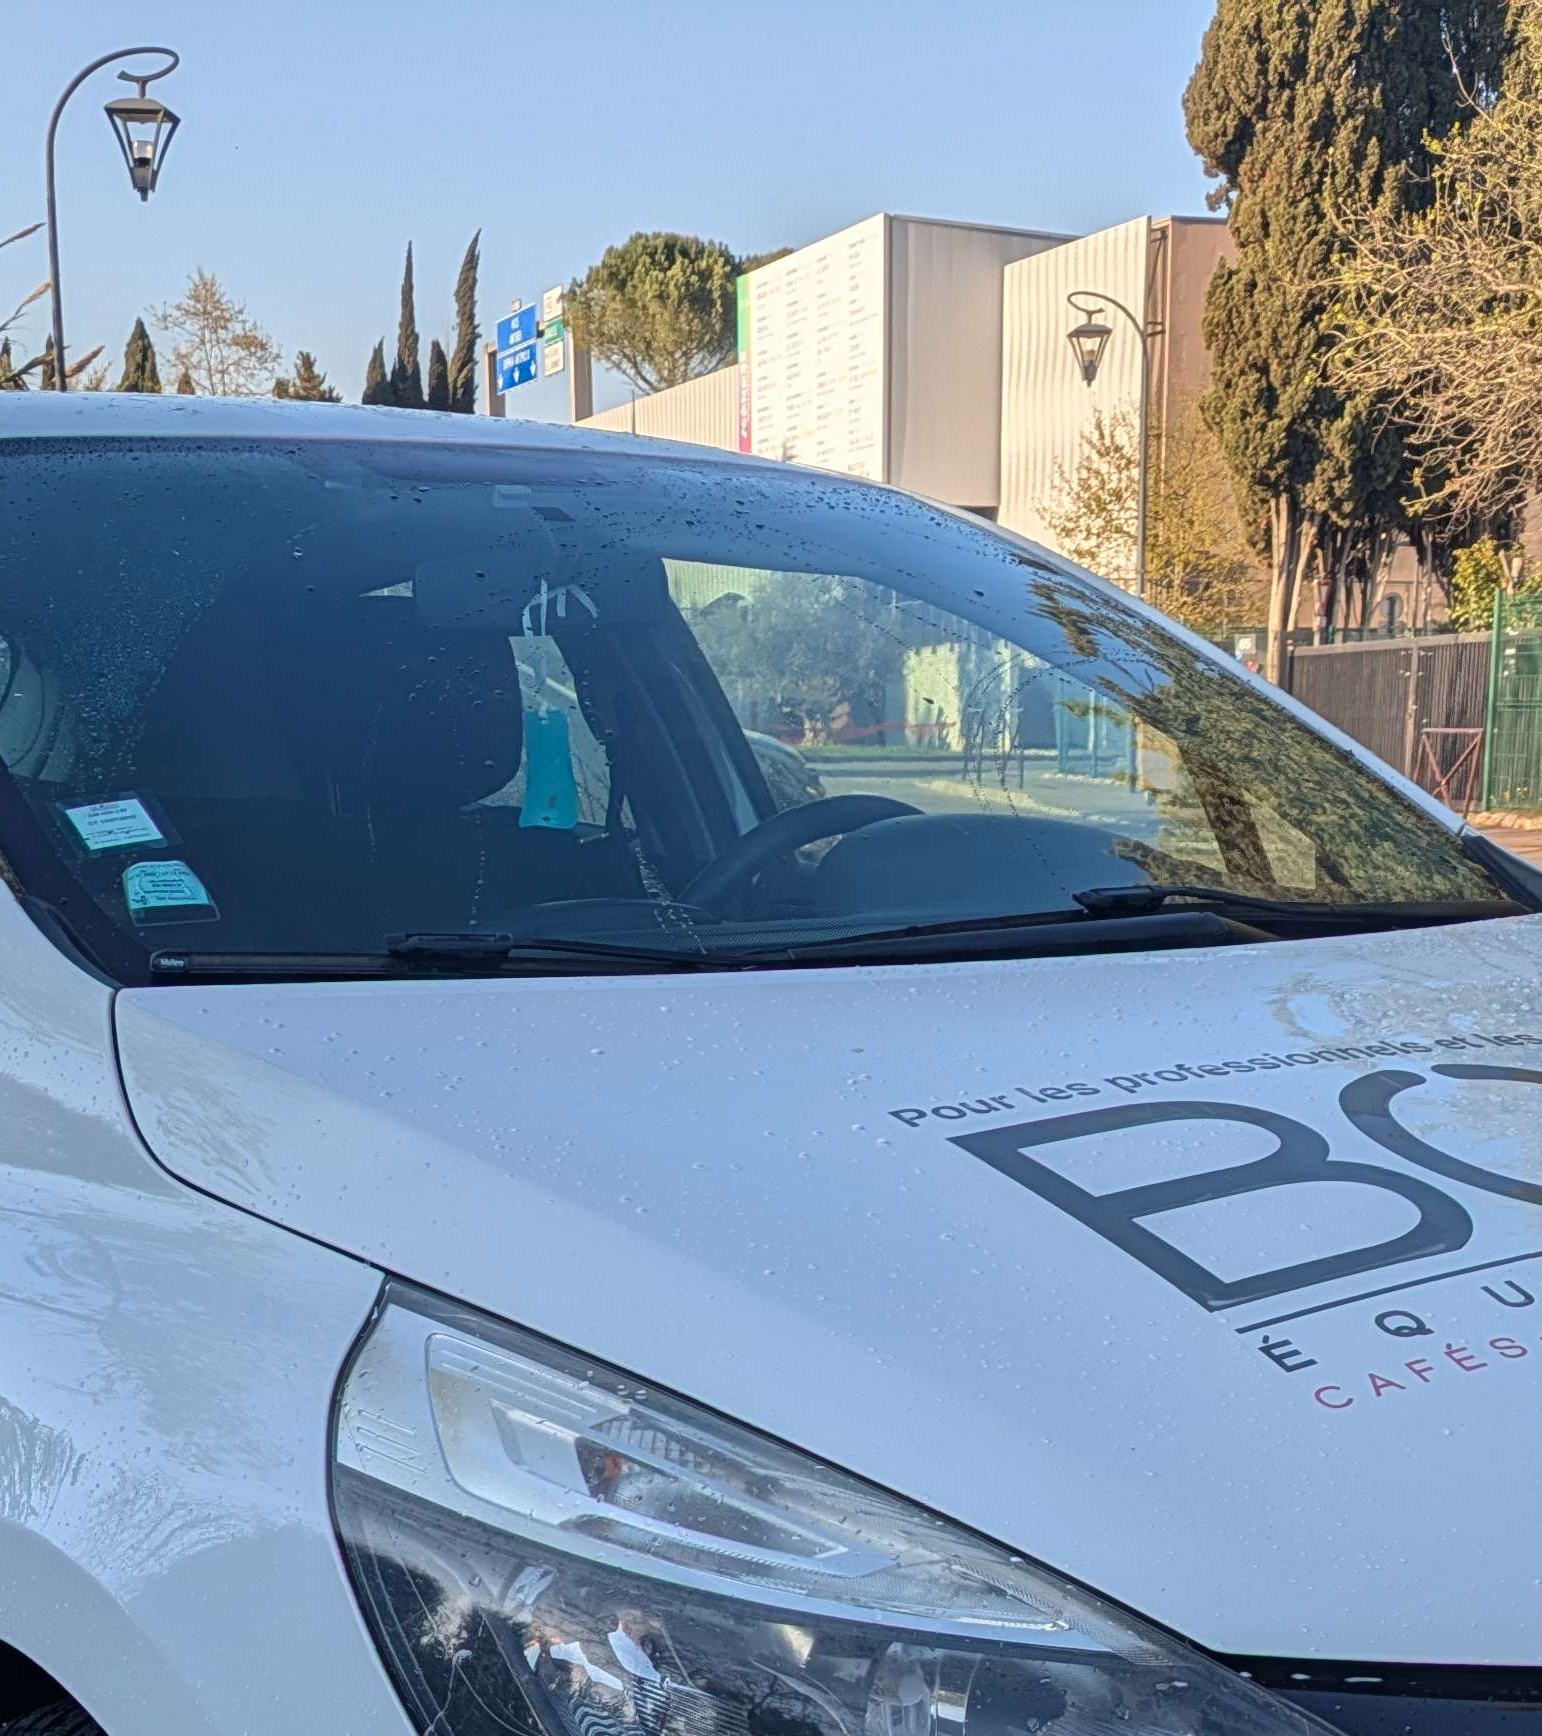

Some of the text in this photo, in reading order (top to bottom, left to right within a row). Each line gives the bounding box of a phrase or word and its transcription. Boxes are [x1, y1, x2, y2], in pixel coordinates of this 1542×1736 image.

[887, 1093, 1017, 1128] Pour
[1015, 1080, 1101, 1104] les
[1104, 1040, 1433, 1094] professionnels
[1434, 1032, 1482, 1051] et
